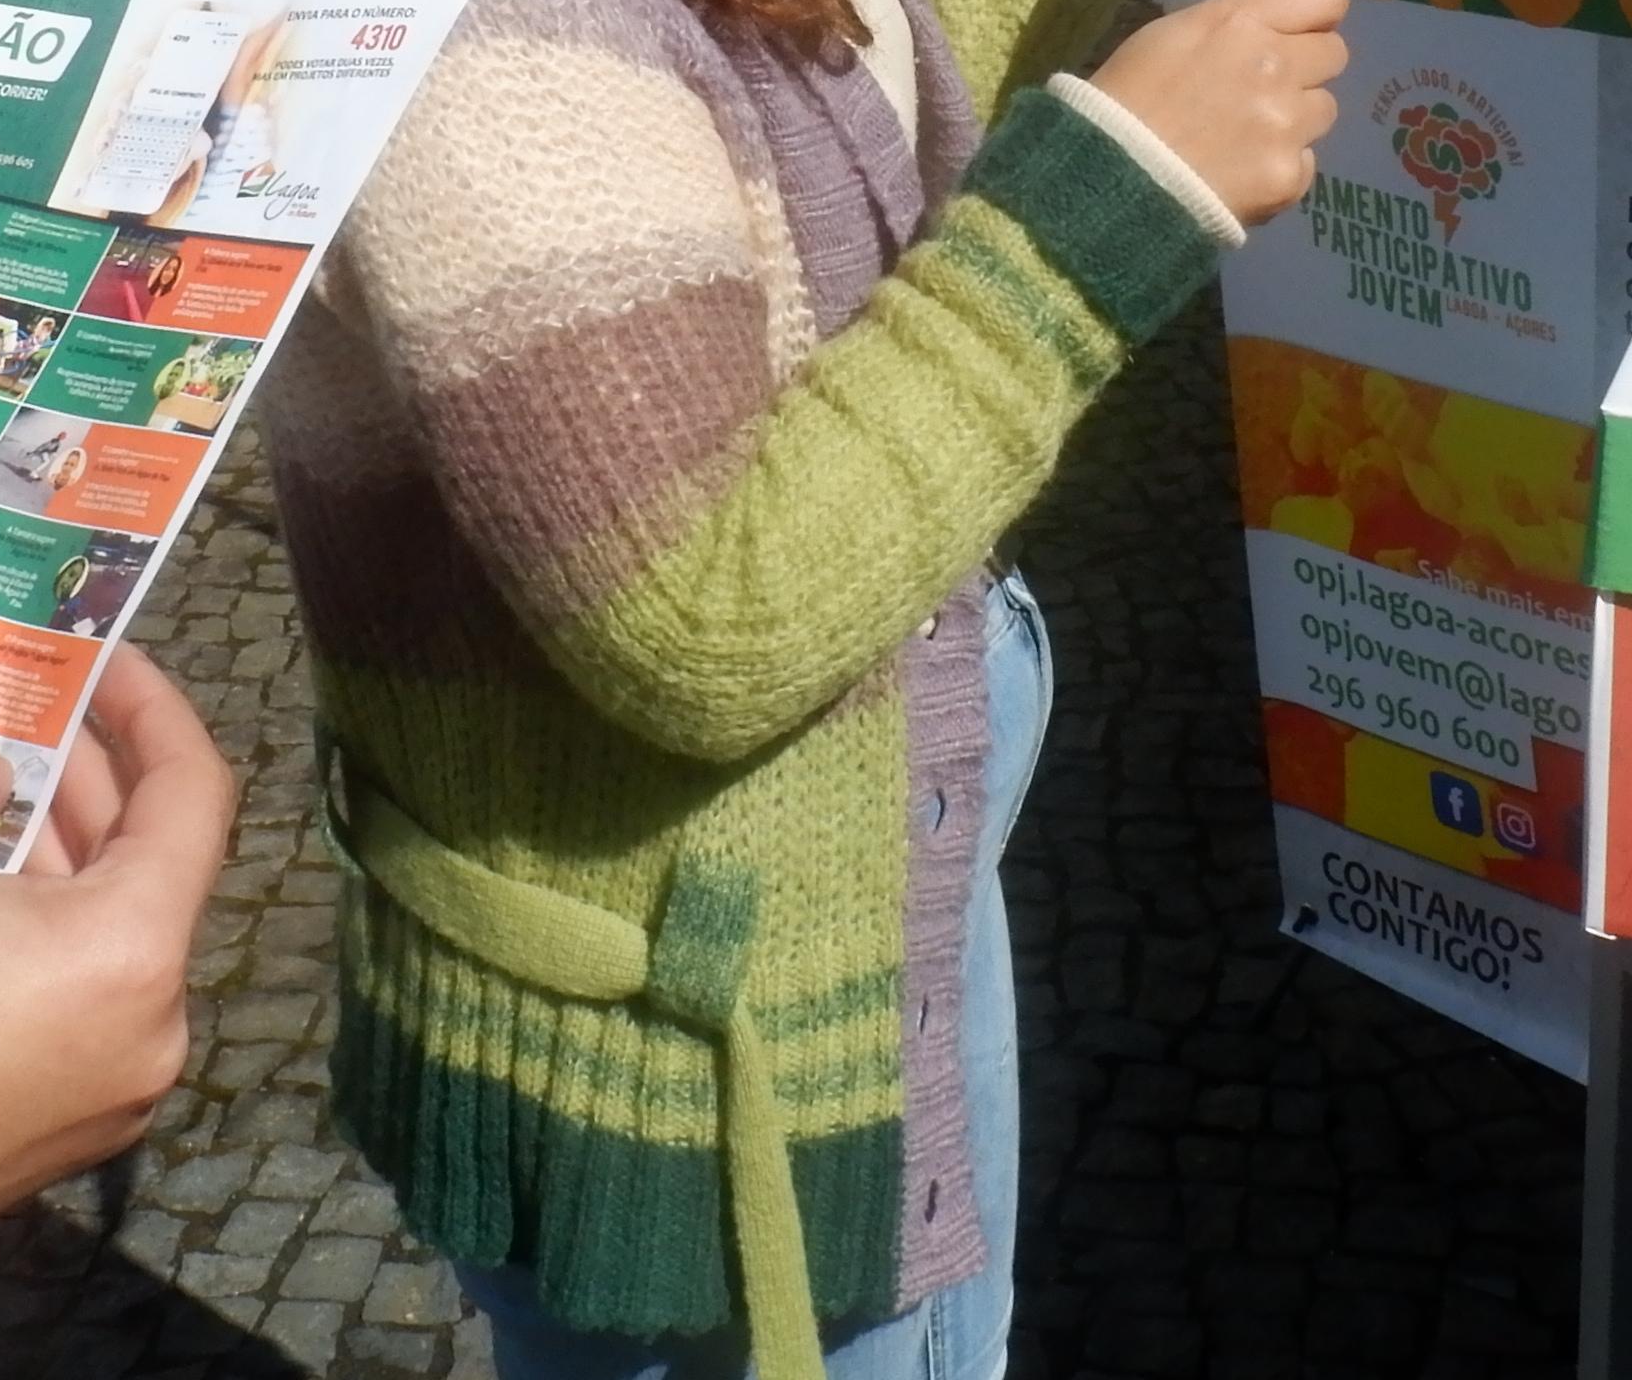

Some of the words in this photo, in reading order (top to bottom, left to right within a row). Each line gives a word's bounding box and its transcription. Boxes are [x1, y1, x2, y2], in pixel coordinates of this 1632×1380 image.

[320, 9, 349, 20] PARA
[351, 8, 361, 19] O
[350, 24, 408, 51] 4310
[1300, 172, 1430, 241] AMENTO
[1312, 209, 1532, 312] PARTICIPATIVO
[1347, 263, 1443, 328] JOVEM
[1294, 556, 1594, 682] opj.lagoa-acores
[1418, 560, 1479, 595] Sabe
[1485, 584, 1546, 617] mais
[1300, 612, 1583, 736] opjovem@lago
[1306, 664, 1365, 710] 296
[1376, 692, 1441, 740] 960
[1452, 716, 1520, 768] 600
[1322, 851, 1544, 964] CONTAMOS
[1327, 891, 1510, 991] CONTIGO!
